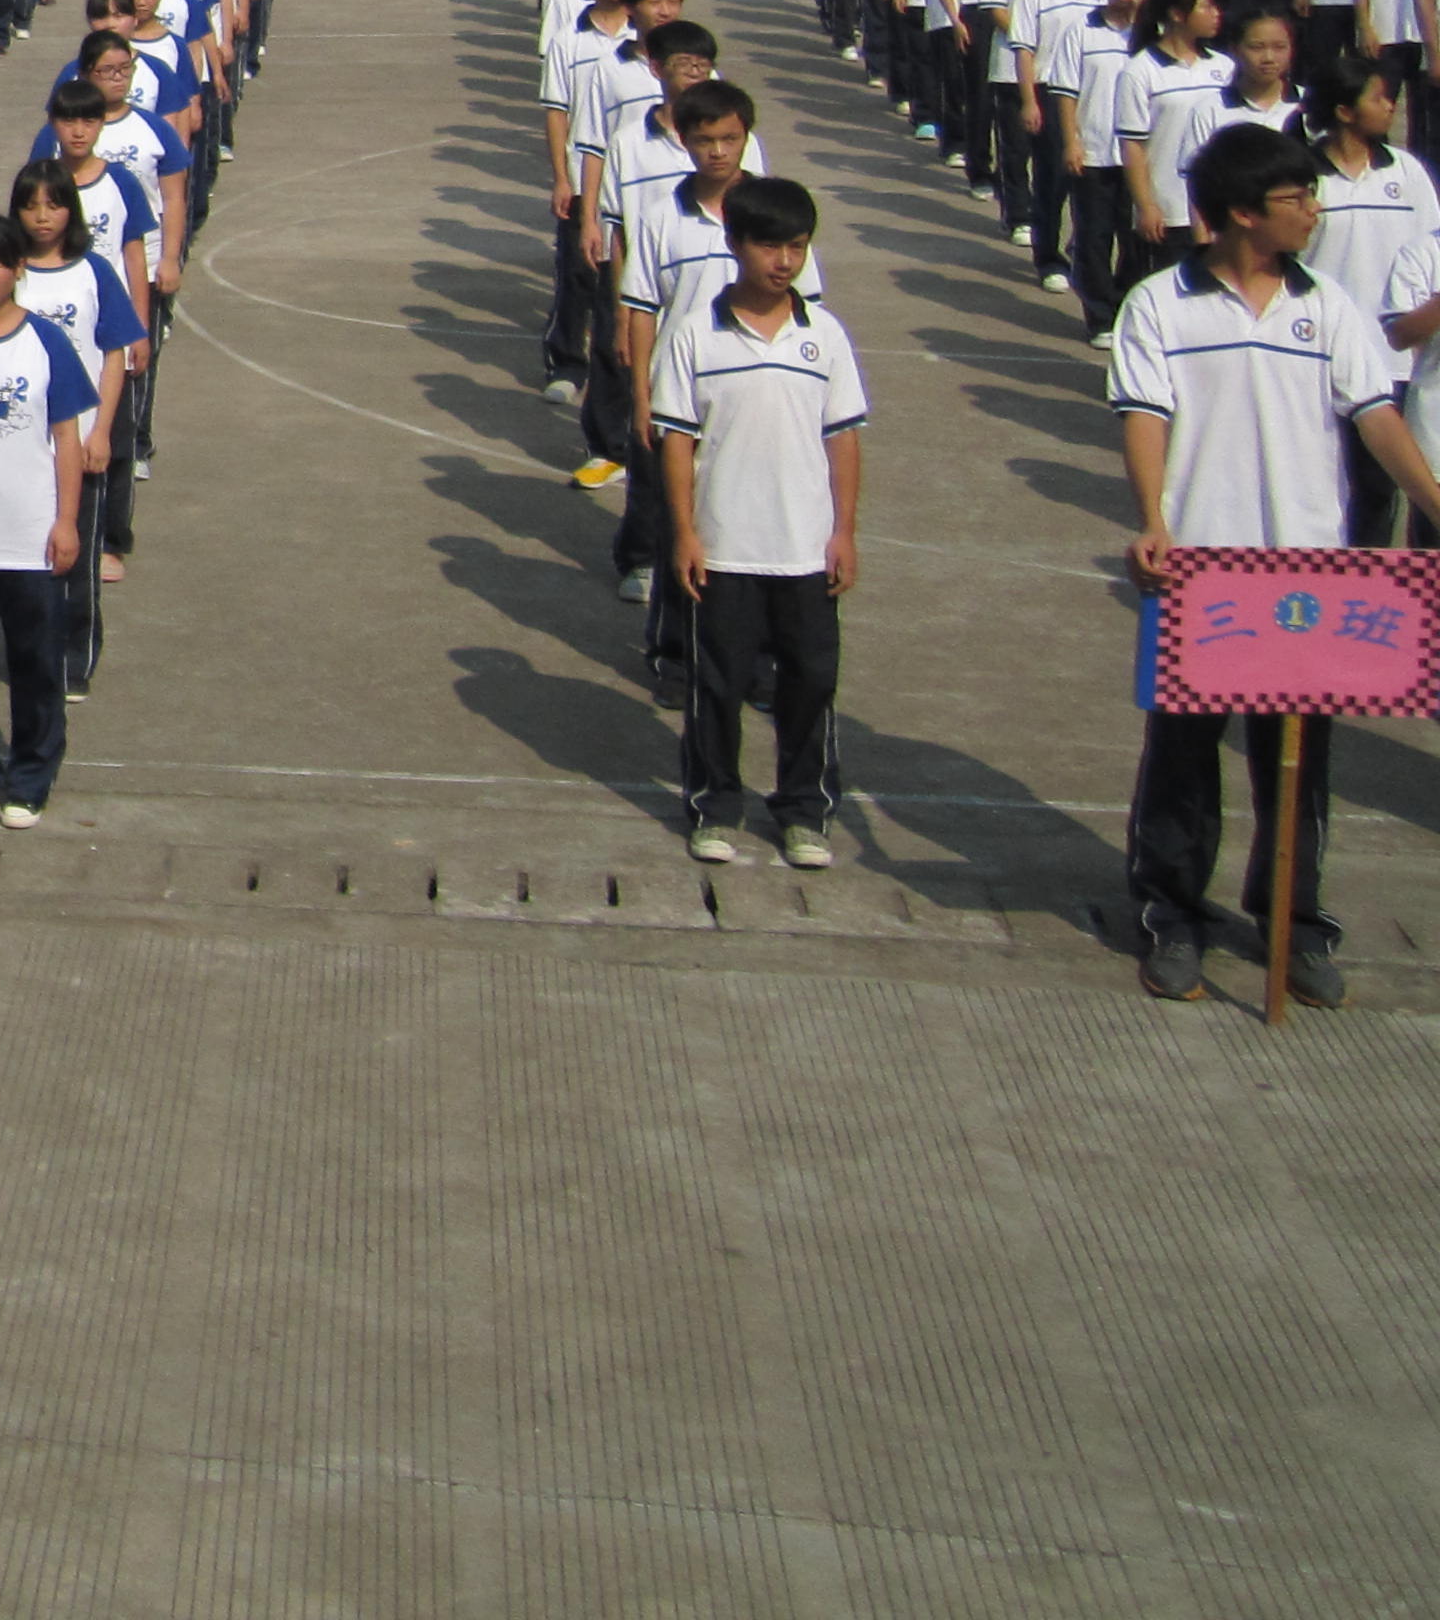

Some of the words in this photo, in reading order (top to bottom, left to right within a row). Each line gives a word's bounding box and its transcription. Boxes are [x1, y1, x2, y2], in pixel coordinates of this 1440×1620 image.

[135, 88, 144, 103] 2
[128, 145, 139, 161] 2
[96, 213, 110, 234] 2
[64, 303, 77, 327] 2
[13, 376, 29, 402] 2
